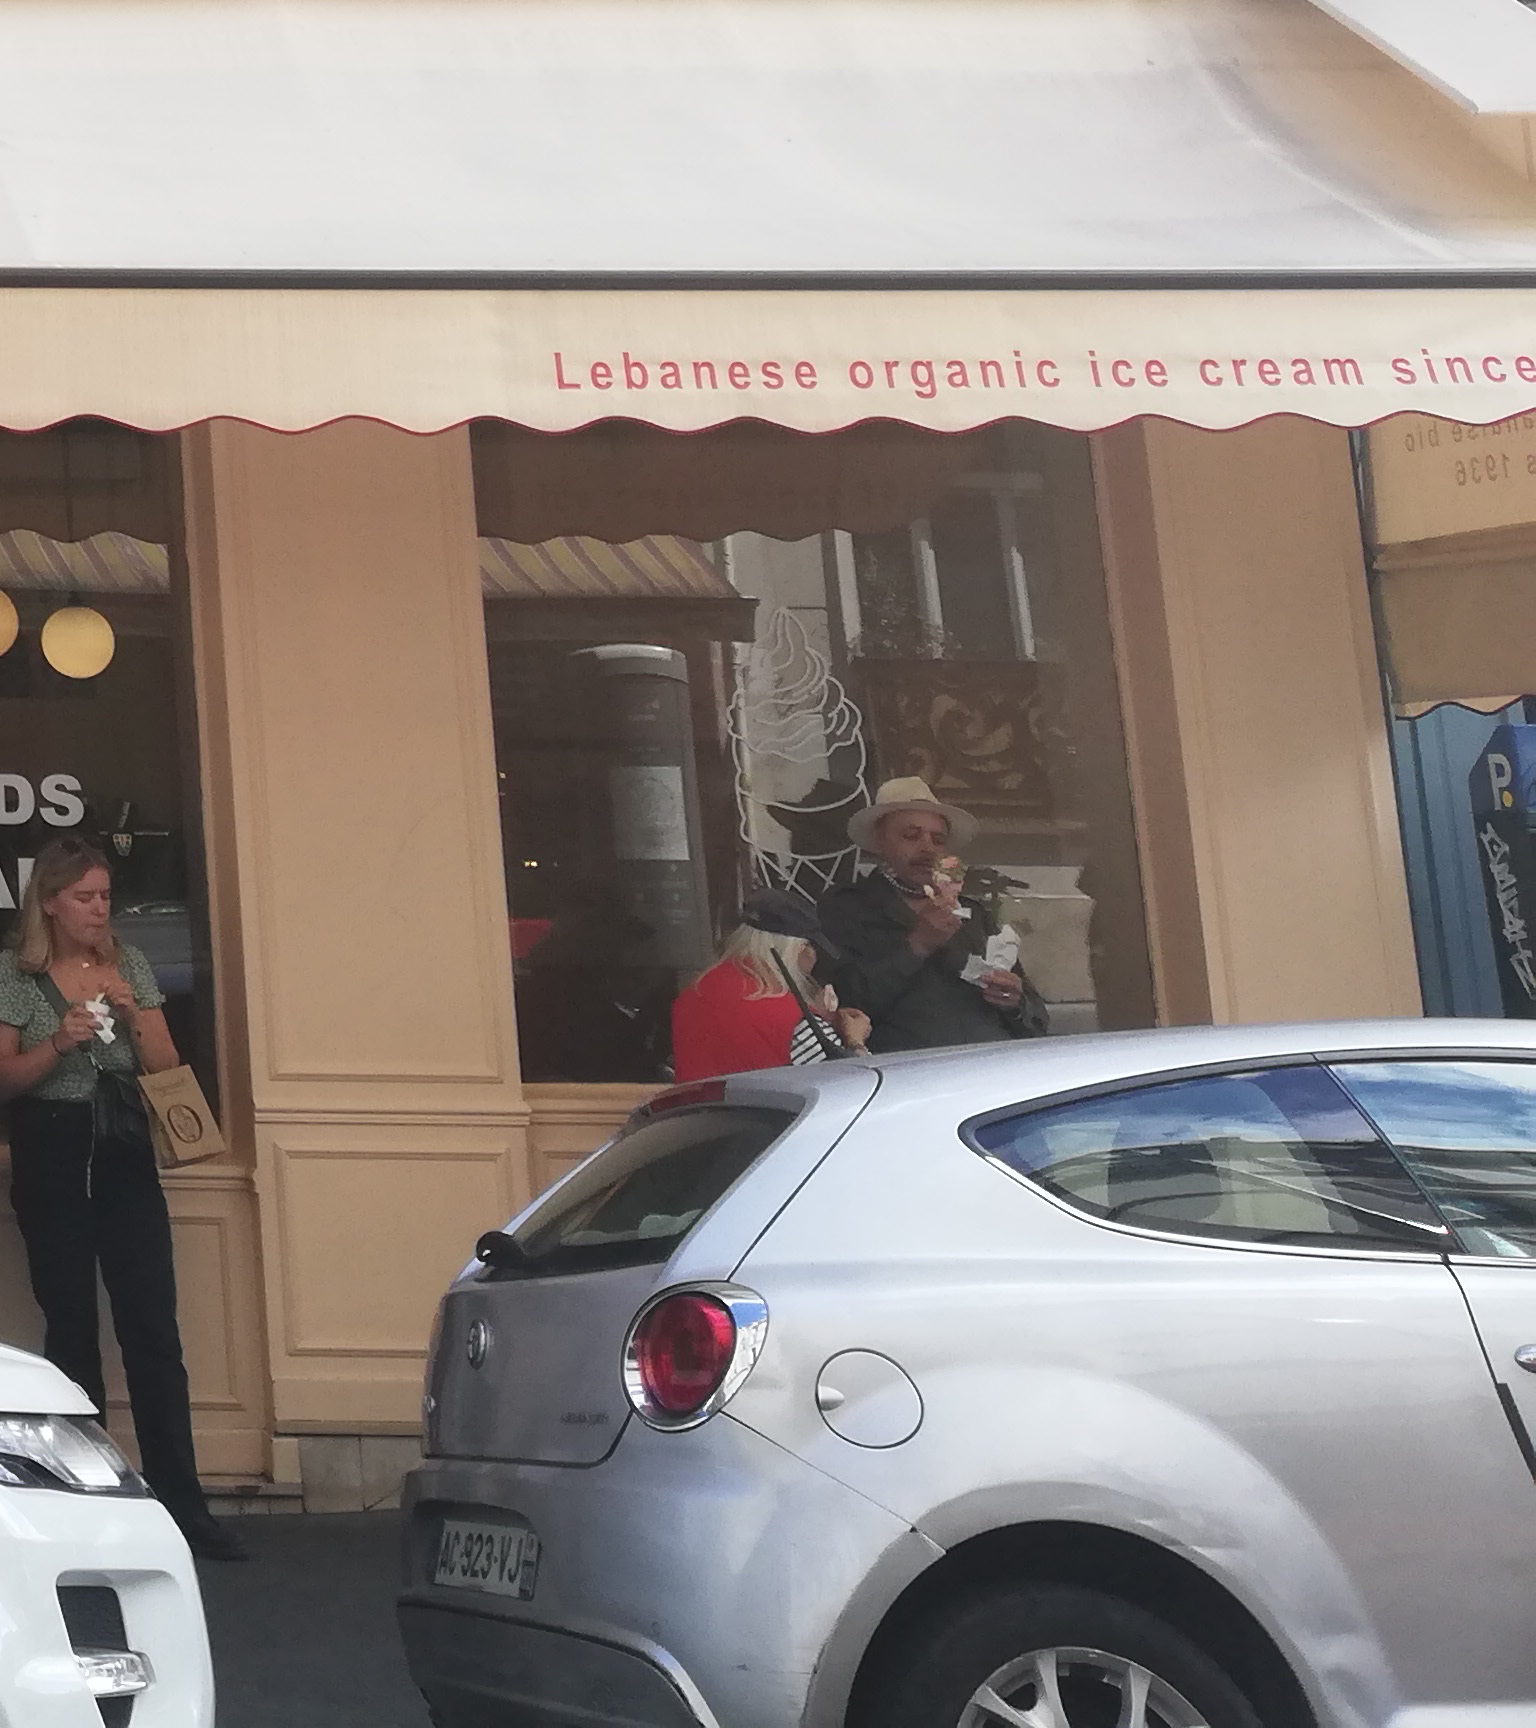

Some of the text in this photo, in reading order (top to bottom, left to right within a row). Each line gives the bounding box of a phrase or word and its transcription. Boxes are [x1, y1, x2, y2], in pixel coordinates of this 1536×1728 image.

[553, 349, 1536, 398] Lebanese organic ice cream since
